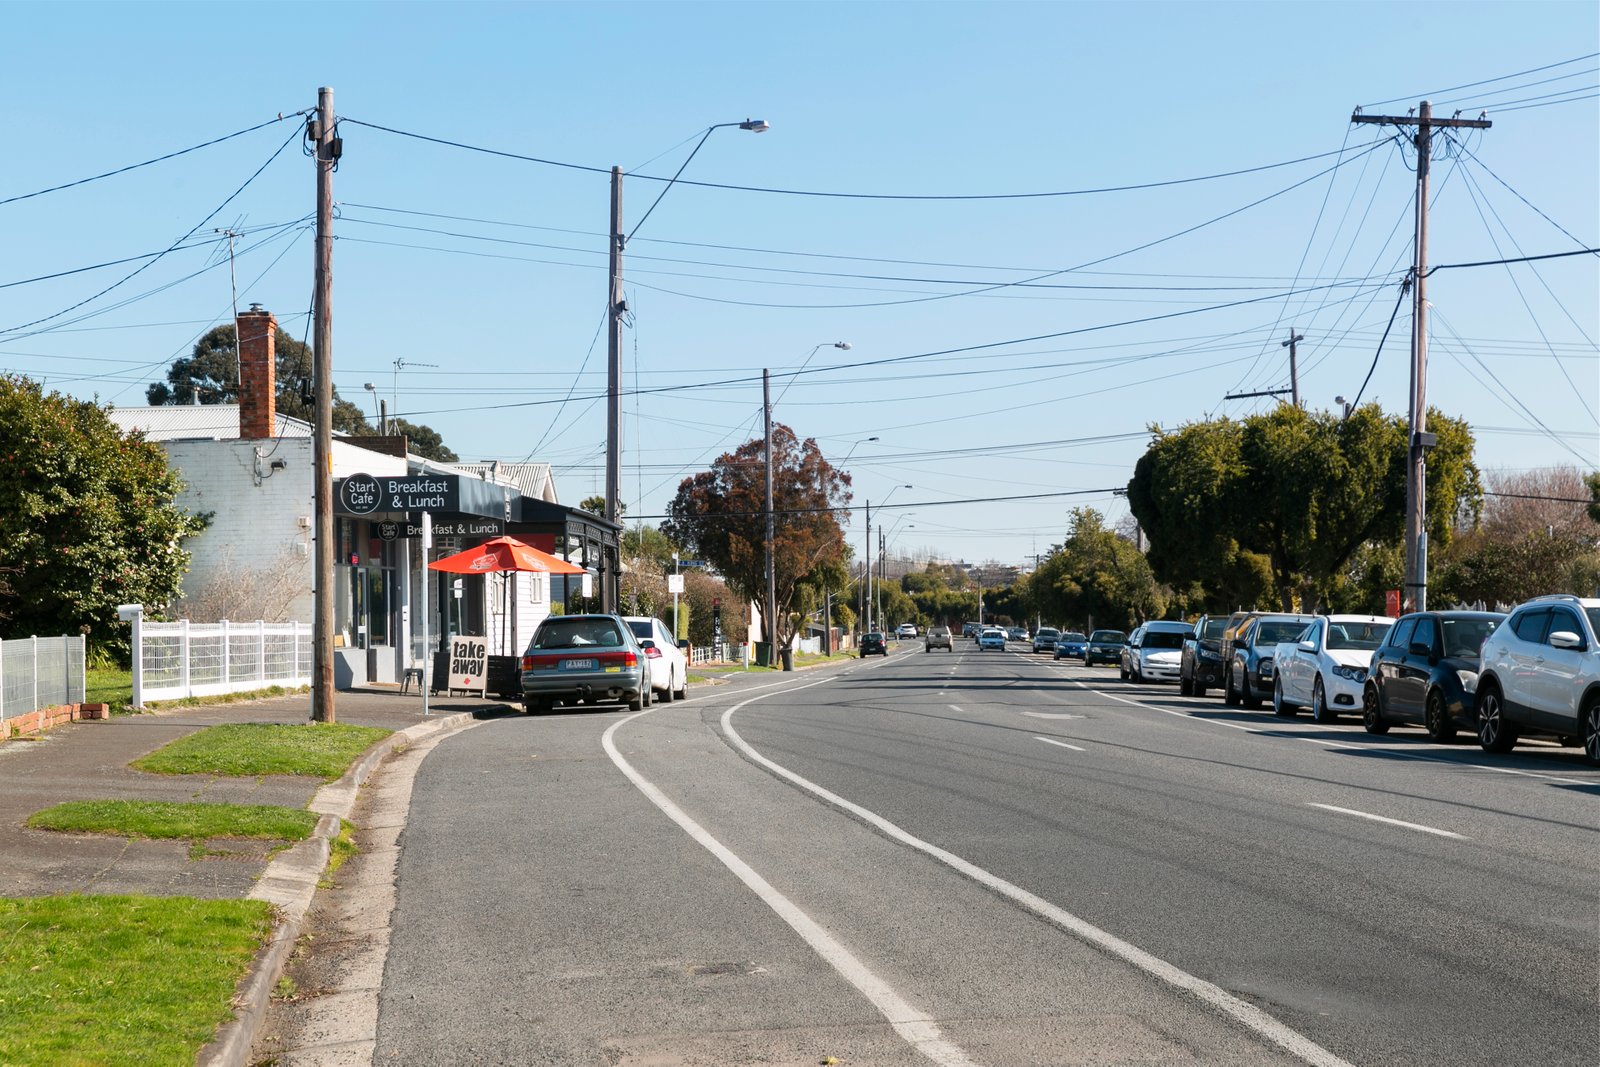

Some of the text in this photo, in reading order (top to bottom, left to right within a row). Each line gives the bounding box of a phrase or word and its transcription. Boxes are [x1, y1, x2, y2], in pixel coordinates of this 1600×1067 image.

[348, 481, 376, 493] Start
[388, 480, 449, 494] Breakfast
[350, 493, 374, 504] Cafe
[392, 494, 445, 508] & Lunch
[407, 522, 499, 535] Brekfast & Lunch
[453, 641, 485, 659] take
[452, 659, 484, 677] away
